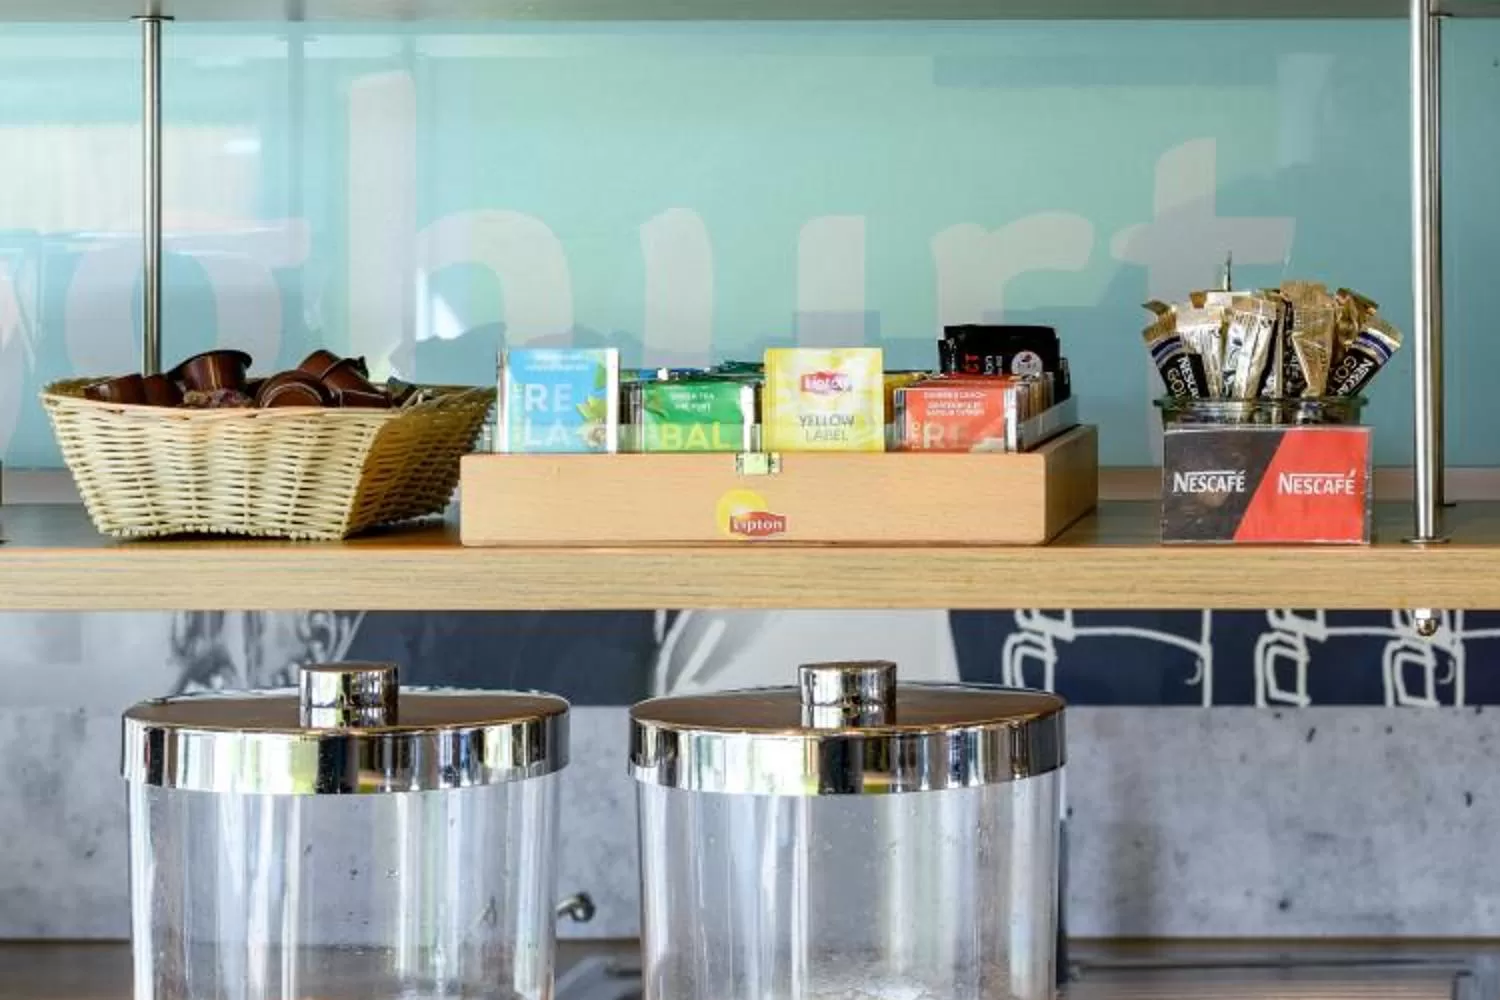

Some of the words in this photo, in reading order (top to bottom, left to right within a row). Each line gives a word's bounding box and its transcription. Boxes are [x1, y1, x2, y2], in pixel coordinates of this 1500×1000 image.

[525, 383, 573, 412] RE
[799, 415, 856, 428] YELLOW
[806, 427, 849, 441] LABEL
[661, 420, 732, 449] BAL
[1172, 468, 1247, 493] NESCAFÉ
[1278, 468, 1356, 495] NESCAFÉ
[732, 516, 784, 534] Lipton
